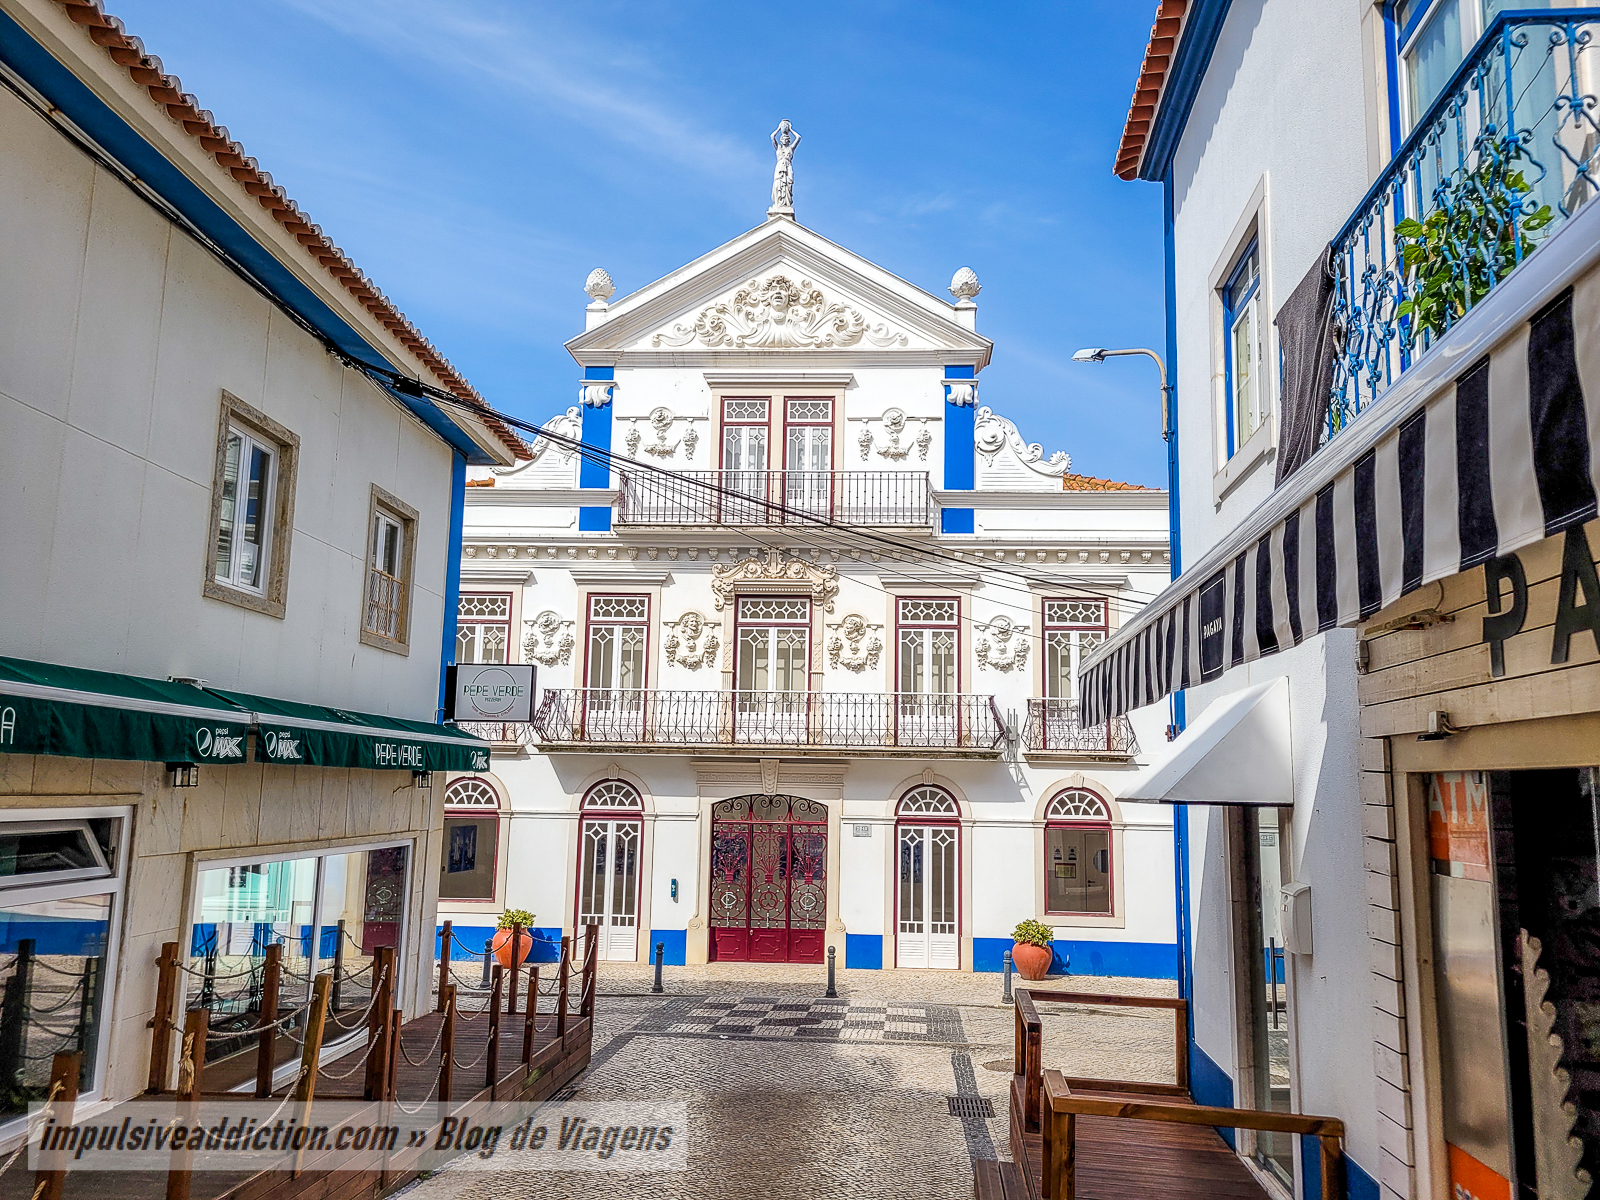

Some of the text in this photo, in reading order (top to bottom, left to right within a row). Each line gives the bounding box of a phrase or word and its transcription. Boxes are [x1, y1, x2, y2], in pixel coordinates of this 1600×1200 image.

[1203, 616, 1223, 640] PAGAYA
[463, 685, 524, 698] PEPE VERDE
[0, 706, 16, 745] A
[215, 727, 229, 736] pepsi
[278, 730, 291, 739] pepsi
[212, 736, 243, 759] MAX
[276, 739, 301, 760] MAX
[375, 743, 423, 767] PEPE VERDE
[1428, 770, 1486, 825] ATM
